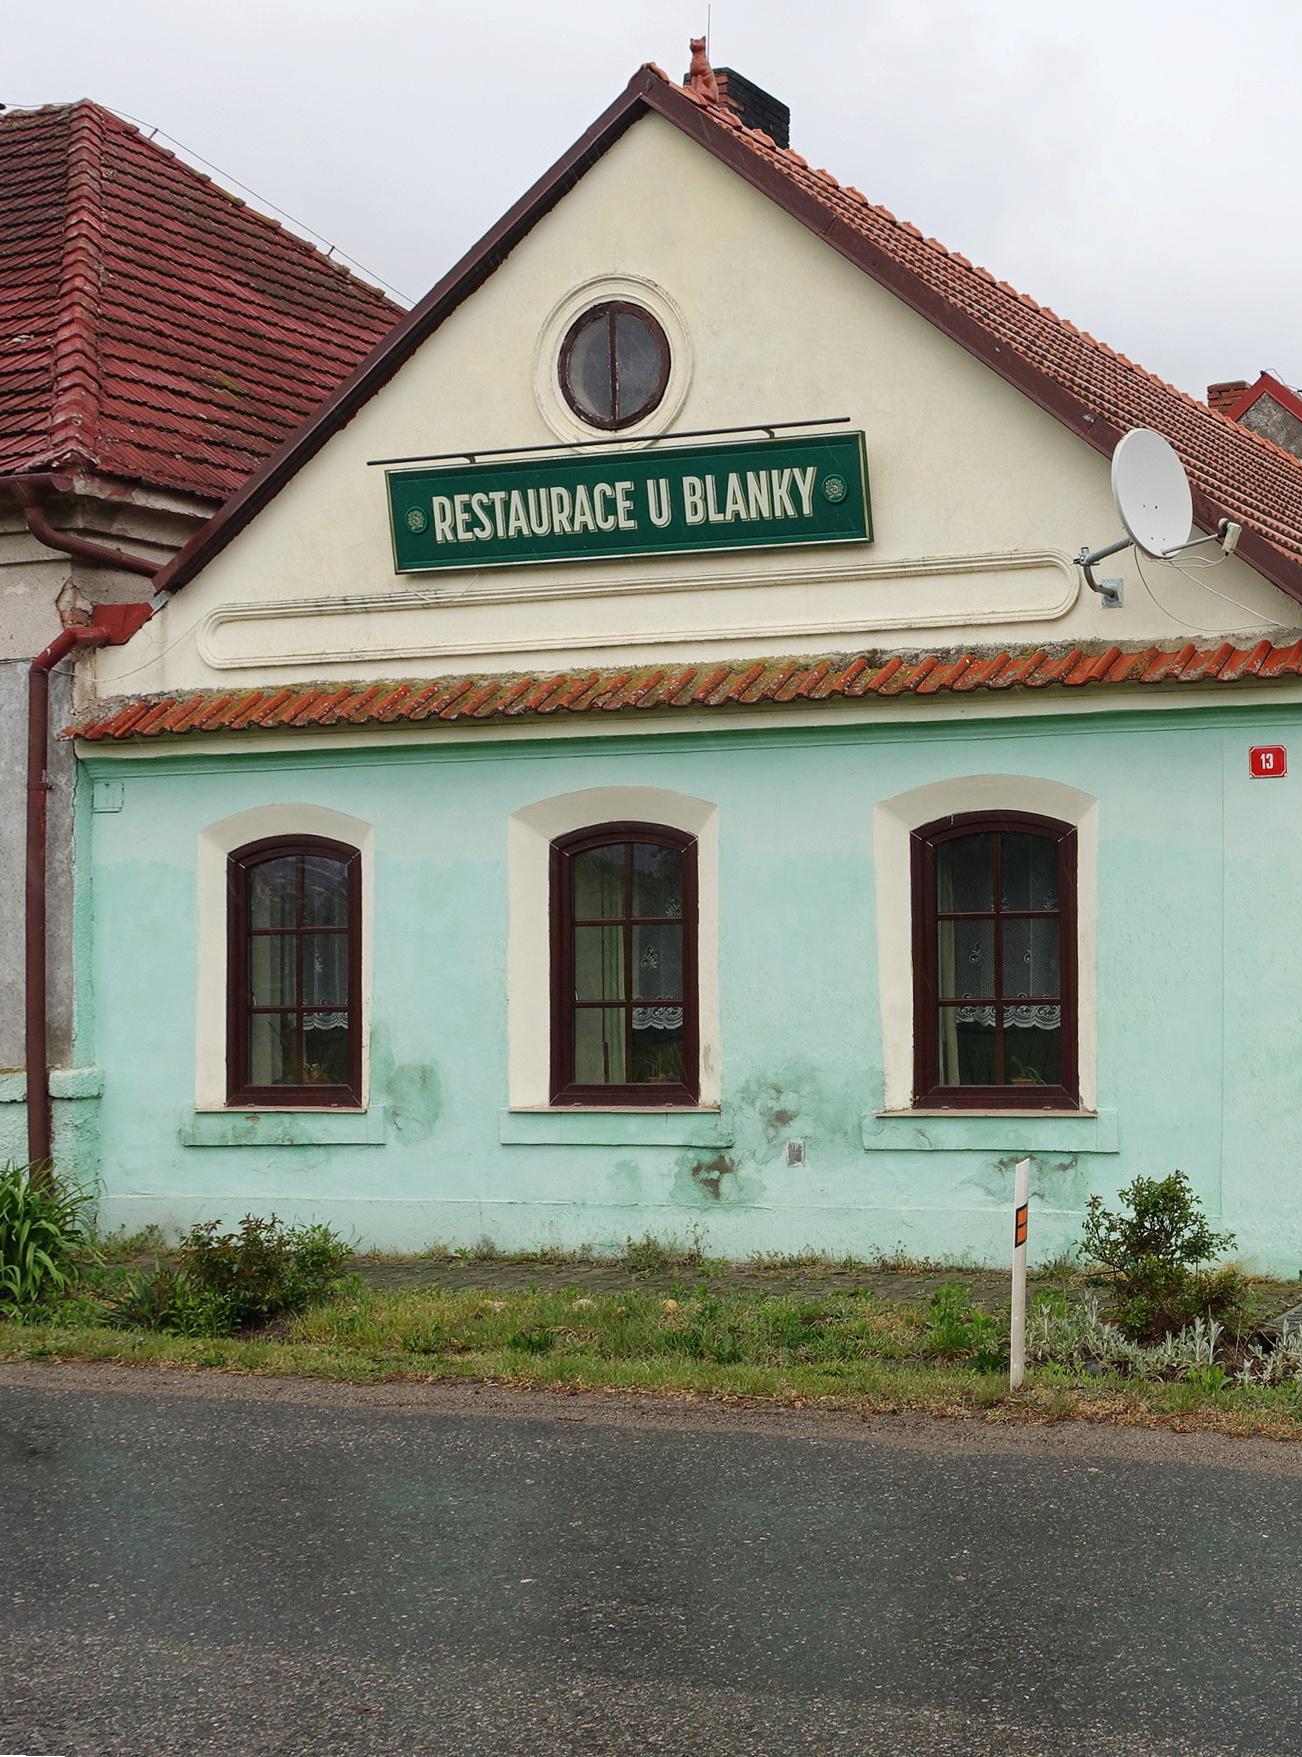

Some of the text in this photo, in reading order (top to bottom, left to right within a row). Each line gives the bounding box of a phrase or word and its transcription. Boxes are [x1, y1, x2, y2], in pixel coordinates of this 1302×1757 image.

[432, 466, 817, 544] RESTAURACE U BLANKY
[1260, 753, 1274, 770] 13
